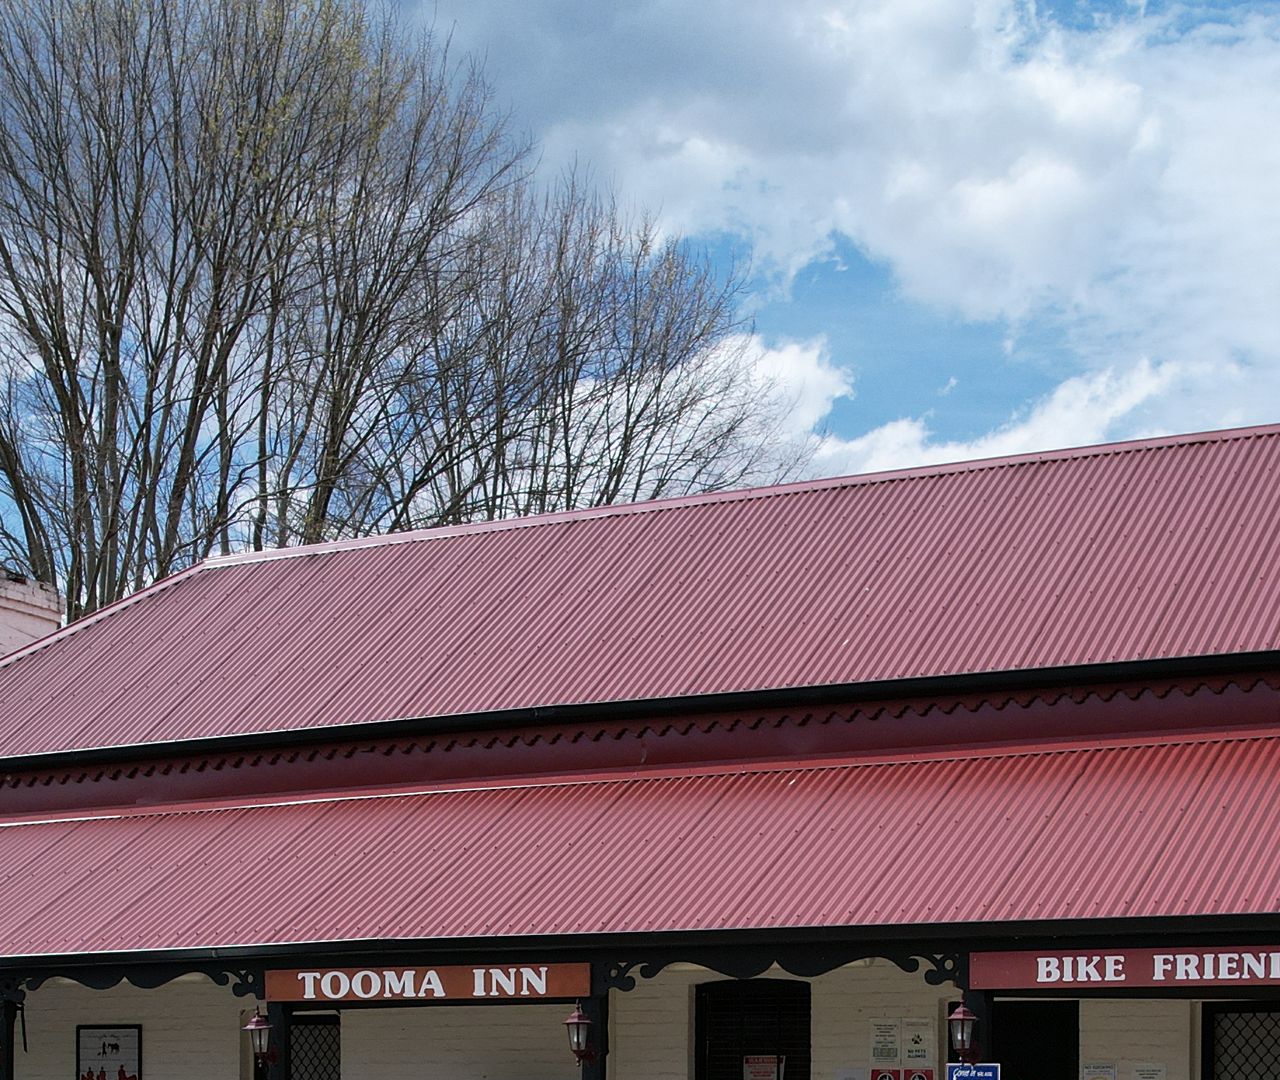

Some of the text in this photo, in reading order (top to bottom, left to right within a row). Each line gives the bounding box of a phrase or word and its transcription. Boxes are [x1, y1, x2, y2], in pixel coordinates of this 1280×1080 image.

[297, 966, 549, 999] TOOMA INN
[1036, 955, 1126, 983] BIKE
